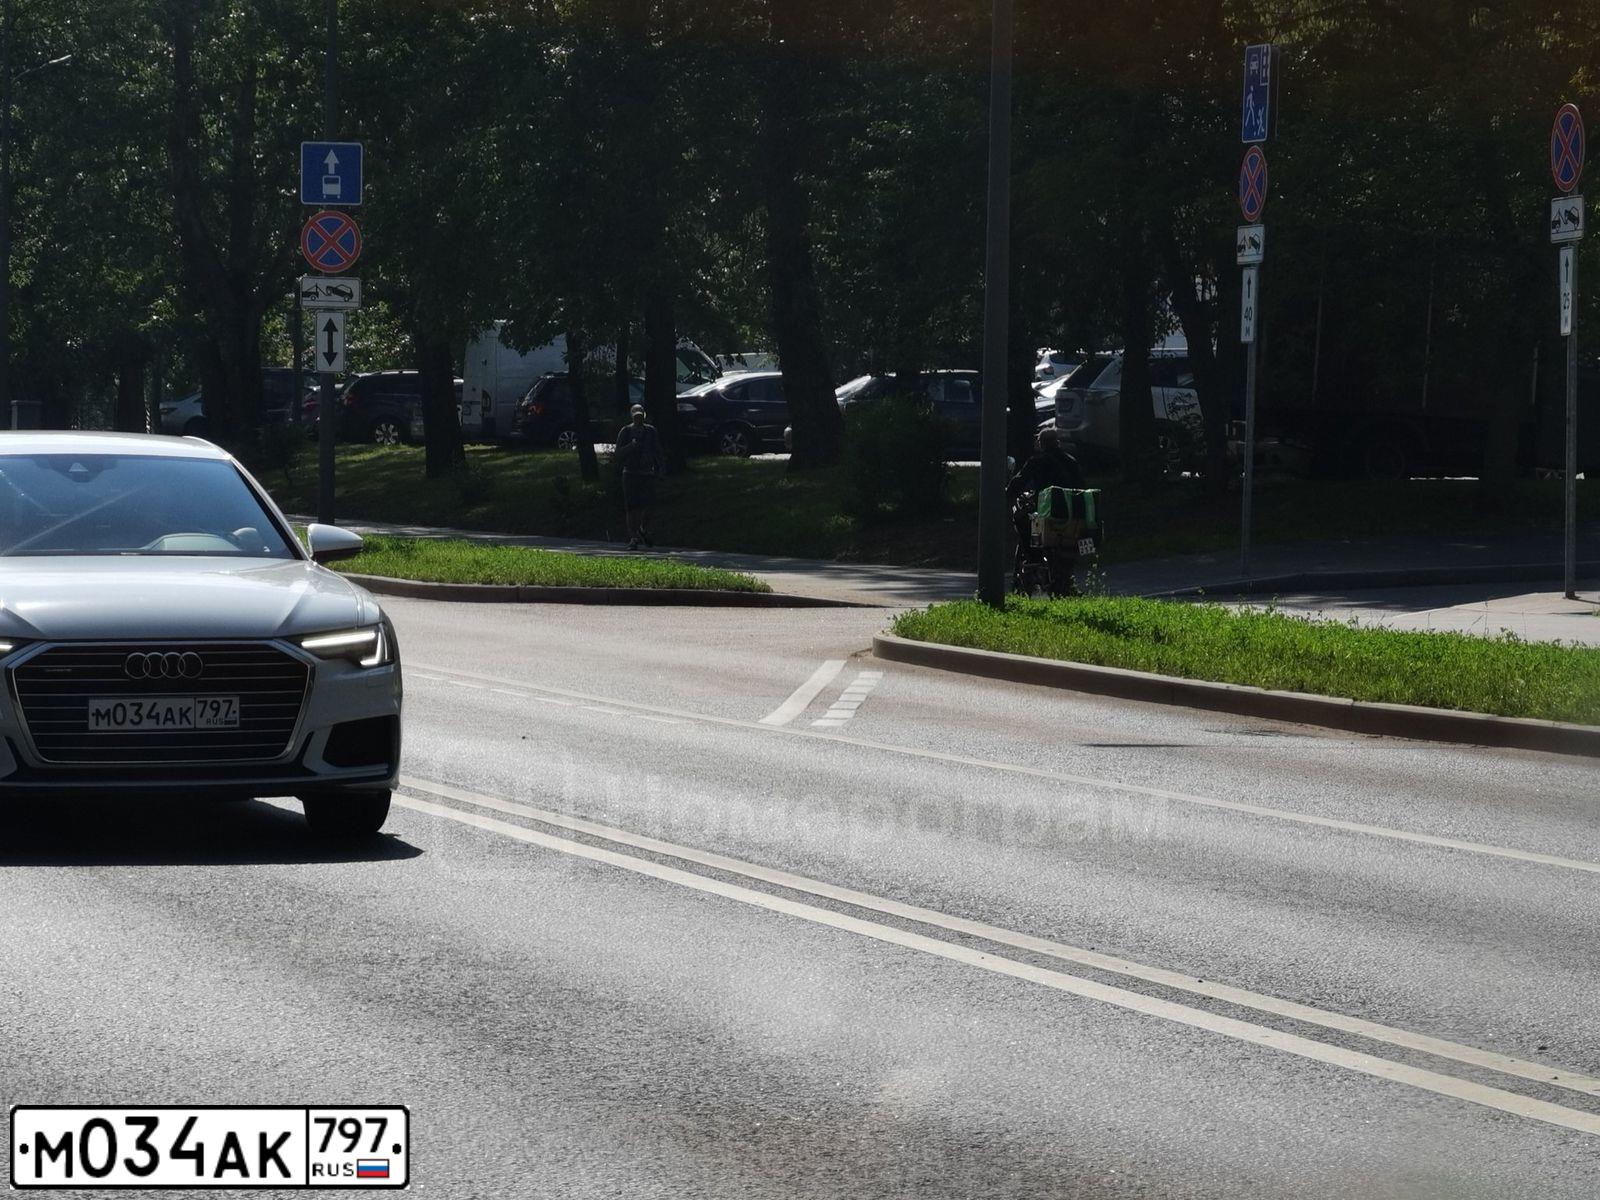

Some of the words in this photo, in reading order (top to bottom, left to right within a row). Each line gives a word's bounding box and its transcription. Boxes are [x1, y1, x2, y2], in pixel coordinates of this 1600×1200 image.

[1244, 306, 1253, 321] 40
[95, 701, 192, 727] М034АК
[197, 699, 233, 718] 797
[206, 718, 224, 726] RUS
